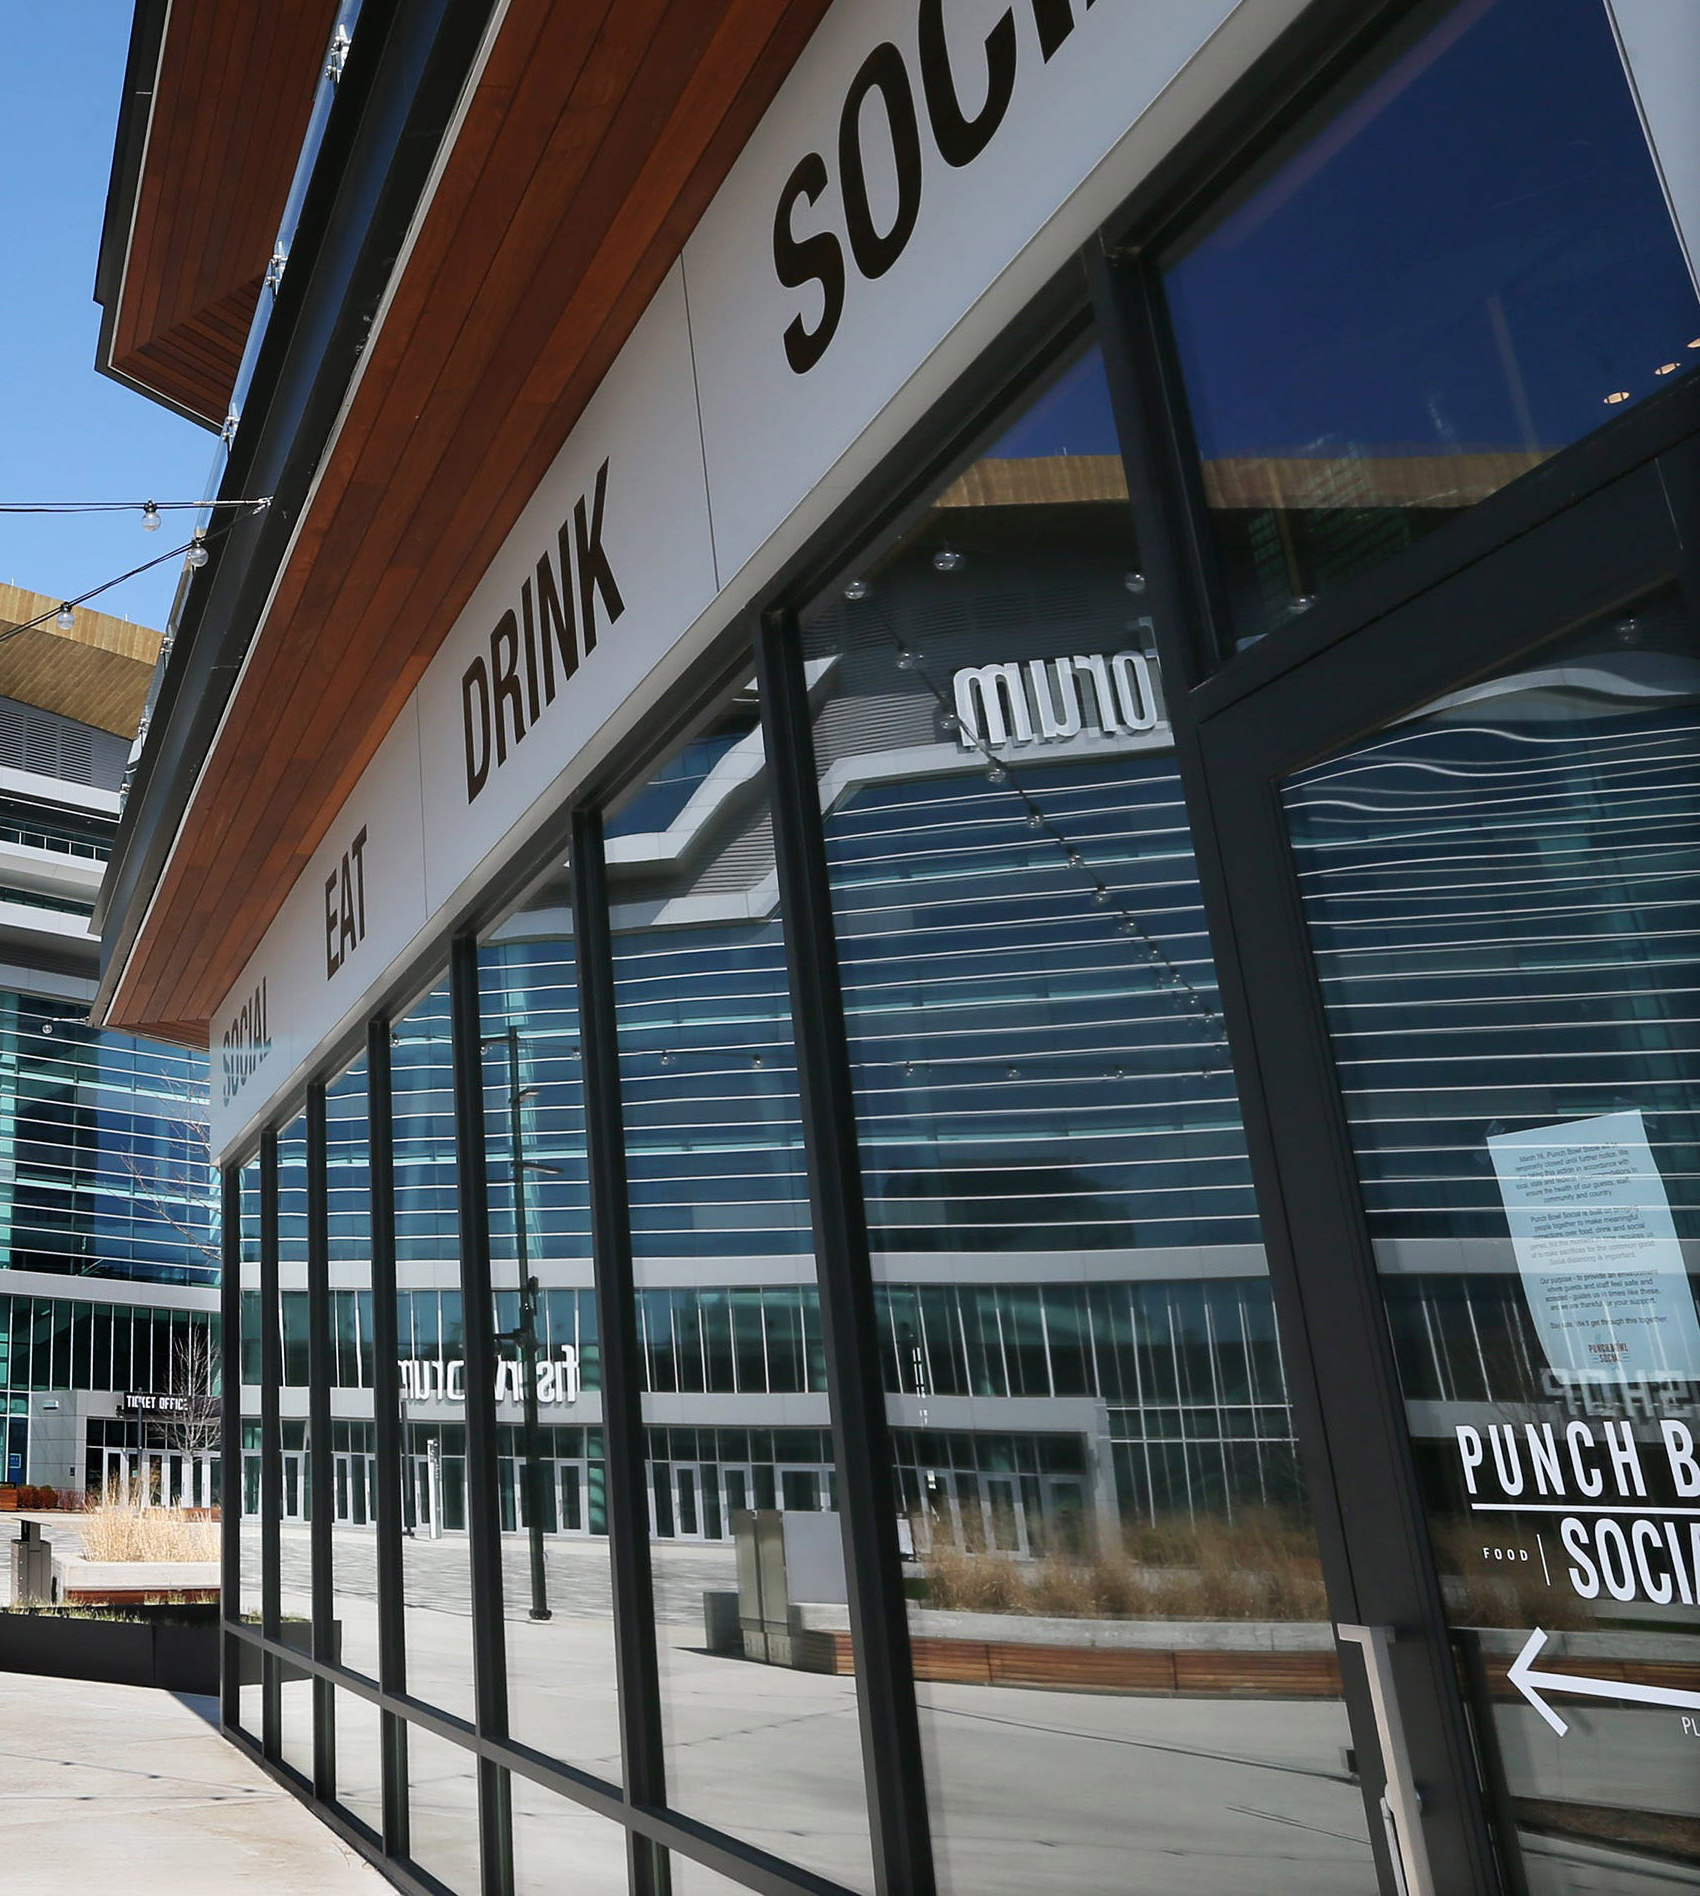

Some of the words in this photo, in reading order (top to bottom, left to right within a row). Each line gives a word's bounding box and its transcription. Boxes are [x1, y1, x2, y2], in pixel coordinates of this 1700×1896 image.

[773, 0, 1115, 375] SOC
[461, 456, 626, 805] DRINK
[324, 824, 368, 981] EAT
[222, 976, 272, 1108] SOCIAL
[126, 1395, 157, 1409] TICKET
[1455, 1420, 1647, 1498] PUNCH
[1483, 1547, 1529, 1562] FOOD
